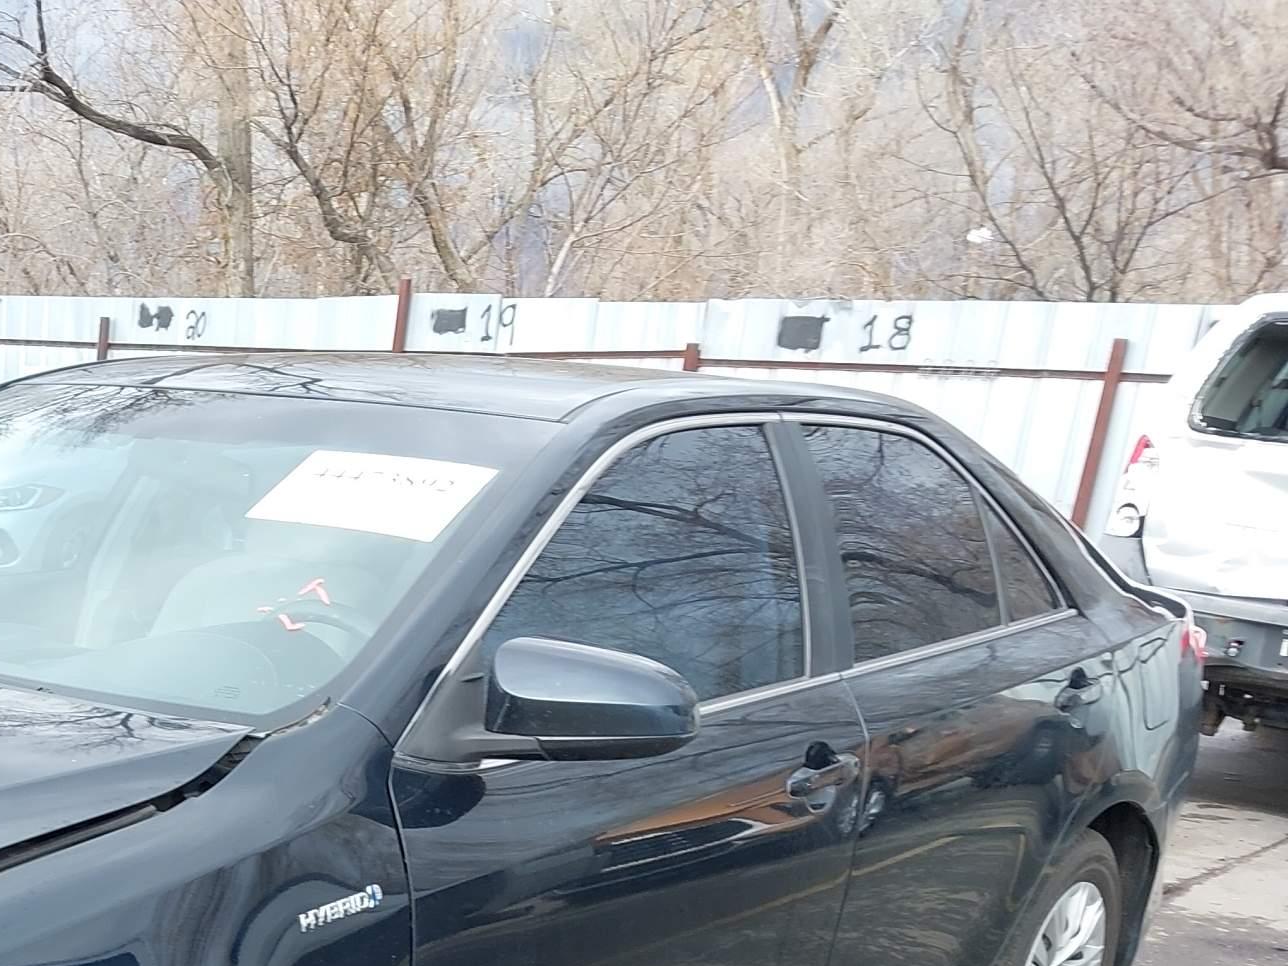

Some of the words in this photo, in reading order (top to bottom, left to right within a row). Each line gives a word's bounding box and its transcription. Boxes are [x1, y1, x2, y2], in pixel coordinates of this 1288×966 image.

[185, 309, 207, 341] 20
[480, 303, 517, 346] 19
[859, 314, 914, 352] 18
[298, 891, 369, 933] HYBRID
